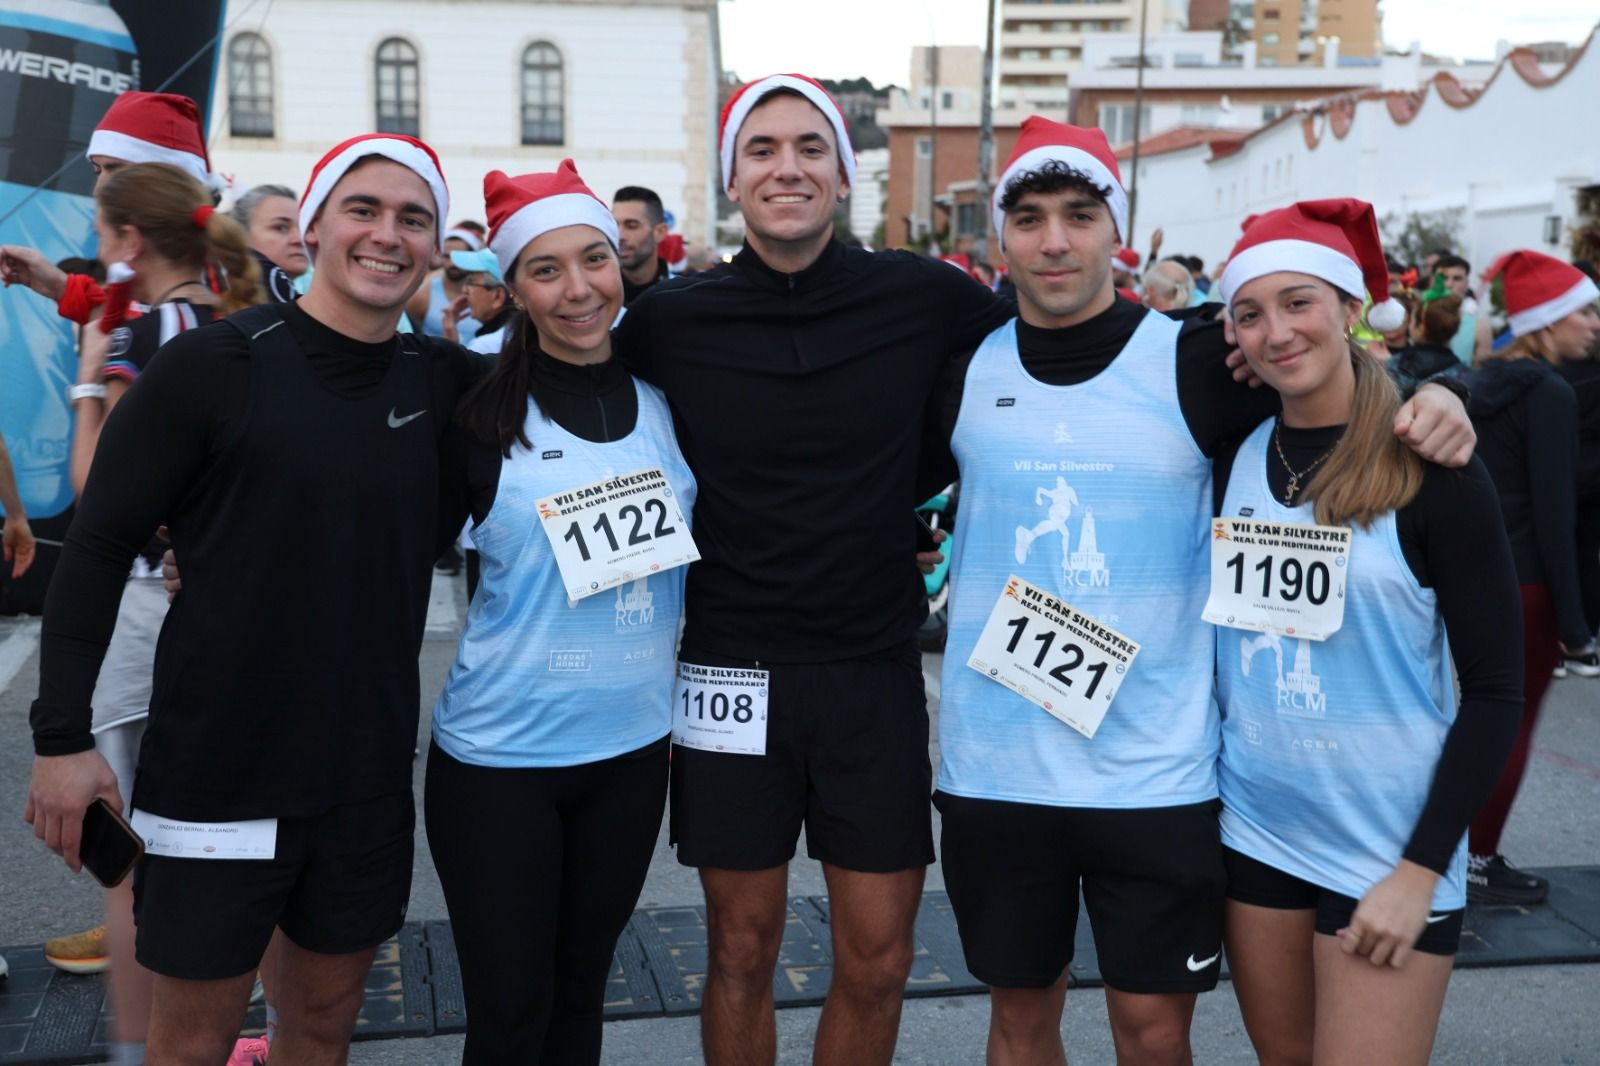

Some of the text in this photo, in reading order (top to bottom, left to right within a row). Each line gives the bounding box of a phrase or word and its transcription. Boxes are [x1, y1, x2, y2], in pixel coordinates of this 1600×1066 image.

[1014, 460, 1115, 472] VII San Silvestre
[554, 470, 663, 506] VII SAN SILVESTRE
[561, 504, 583, 516] REAL
[586, 497, 607, 508] CLUB
[564, 498, 676, 562] 1122
[1232, 522, 1348, 543] VII SAN SILVESTRE
[1233, 536, 1256, 545] REAL
[1259, 538, 1280, 547] CLUB
[1064, 569, 1110, 587] RCM
[1227, 552, 1330, 606] 1190
[616, 606, 655, 625] RCM
[1020, 599, 1042, 615] REAL
[1044, 611, 1065, 626] CLUB
[1024, 586, 1137, 655] VII SAN SILVESTRE
[1006, 616, 1108, 700] 1121
[691, 667, 708, 676] SAN
[711, 669, 767, 679] SILVESTRE
[682, 688, 753, 723] 1108
[1277, 690, 1326, 711] RCM
